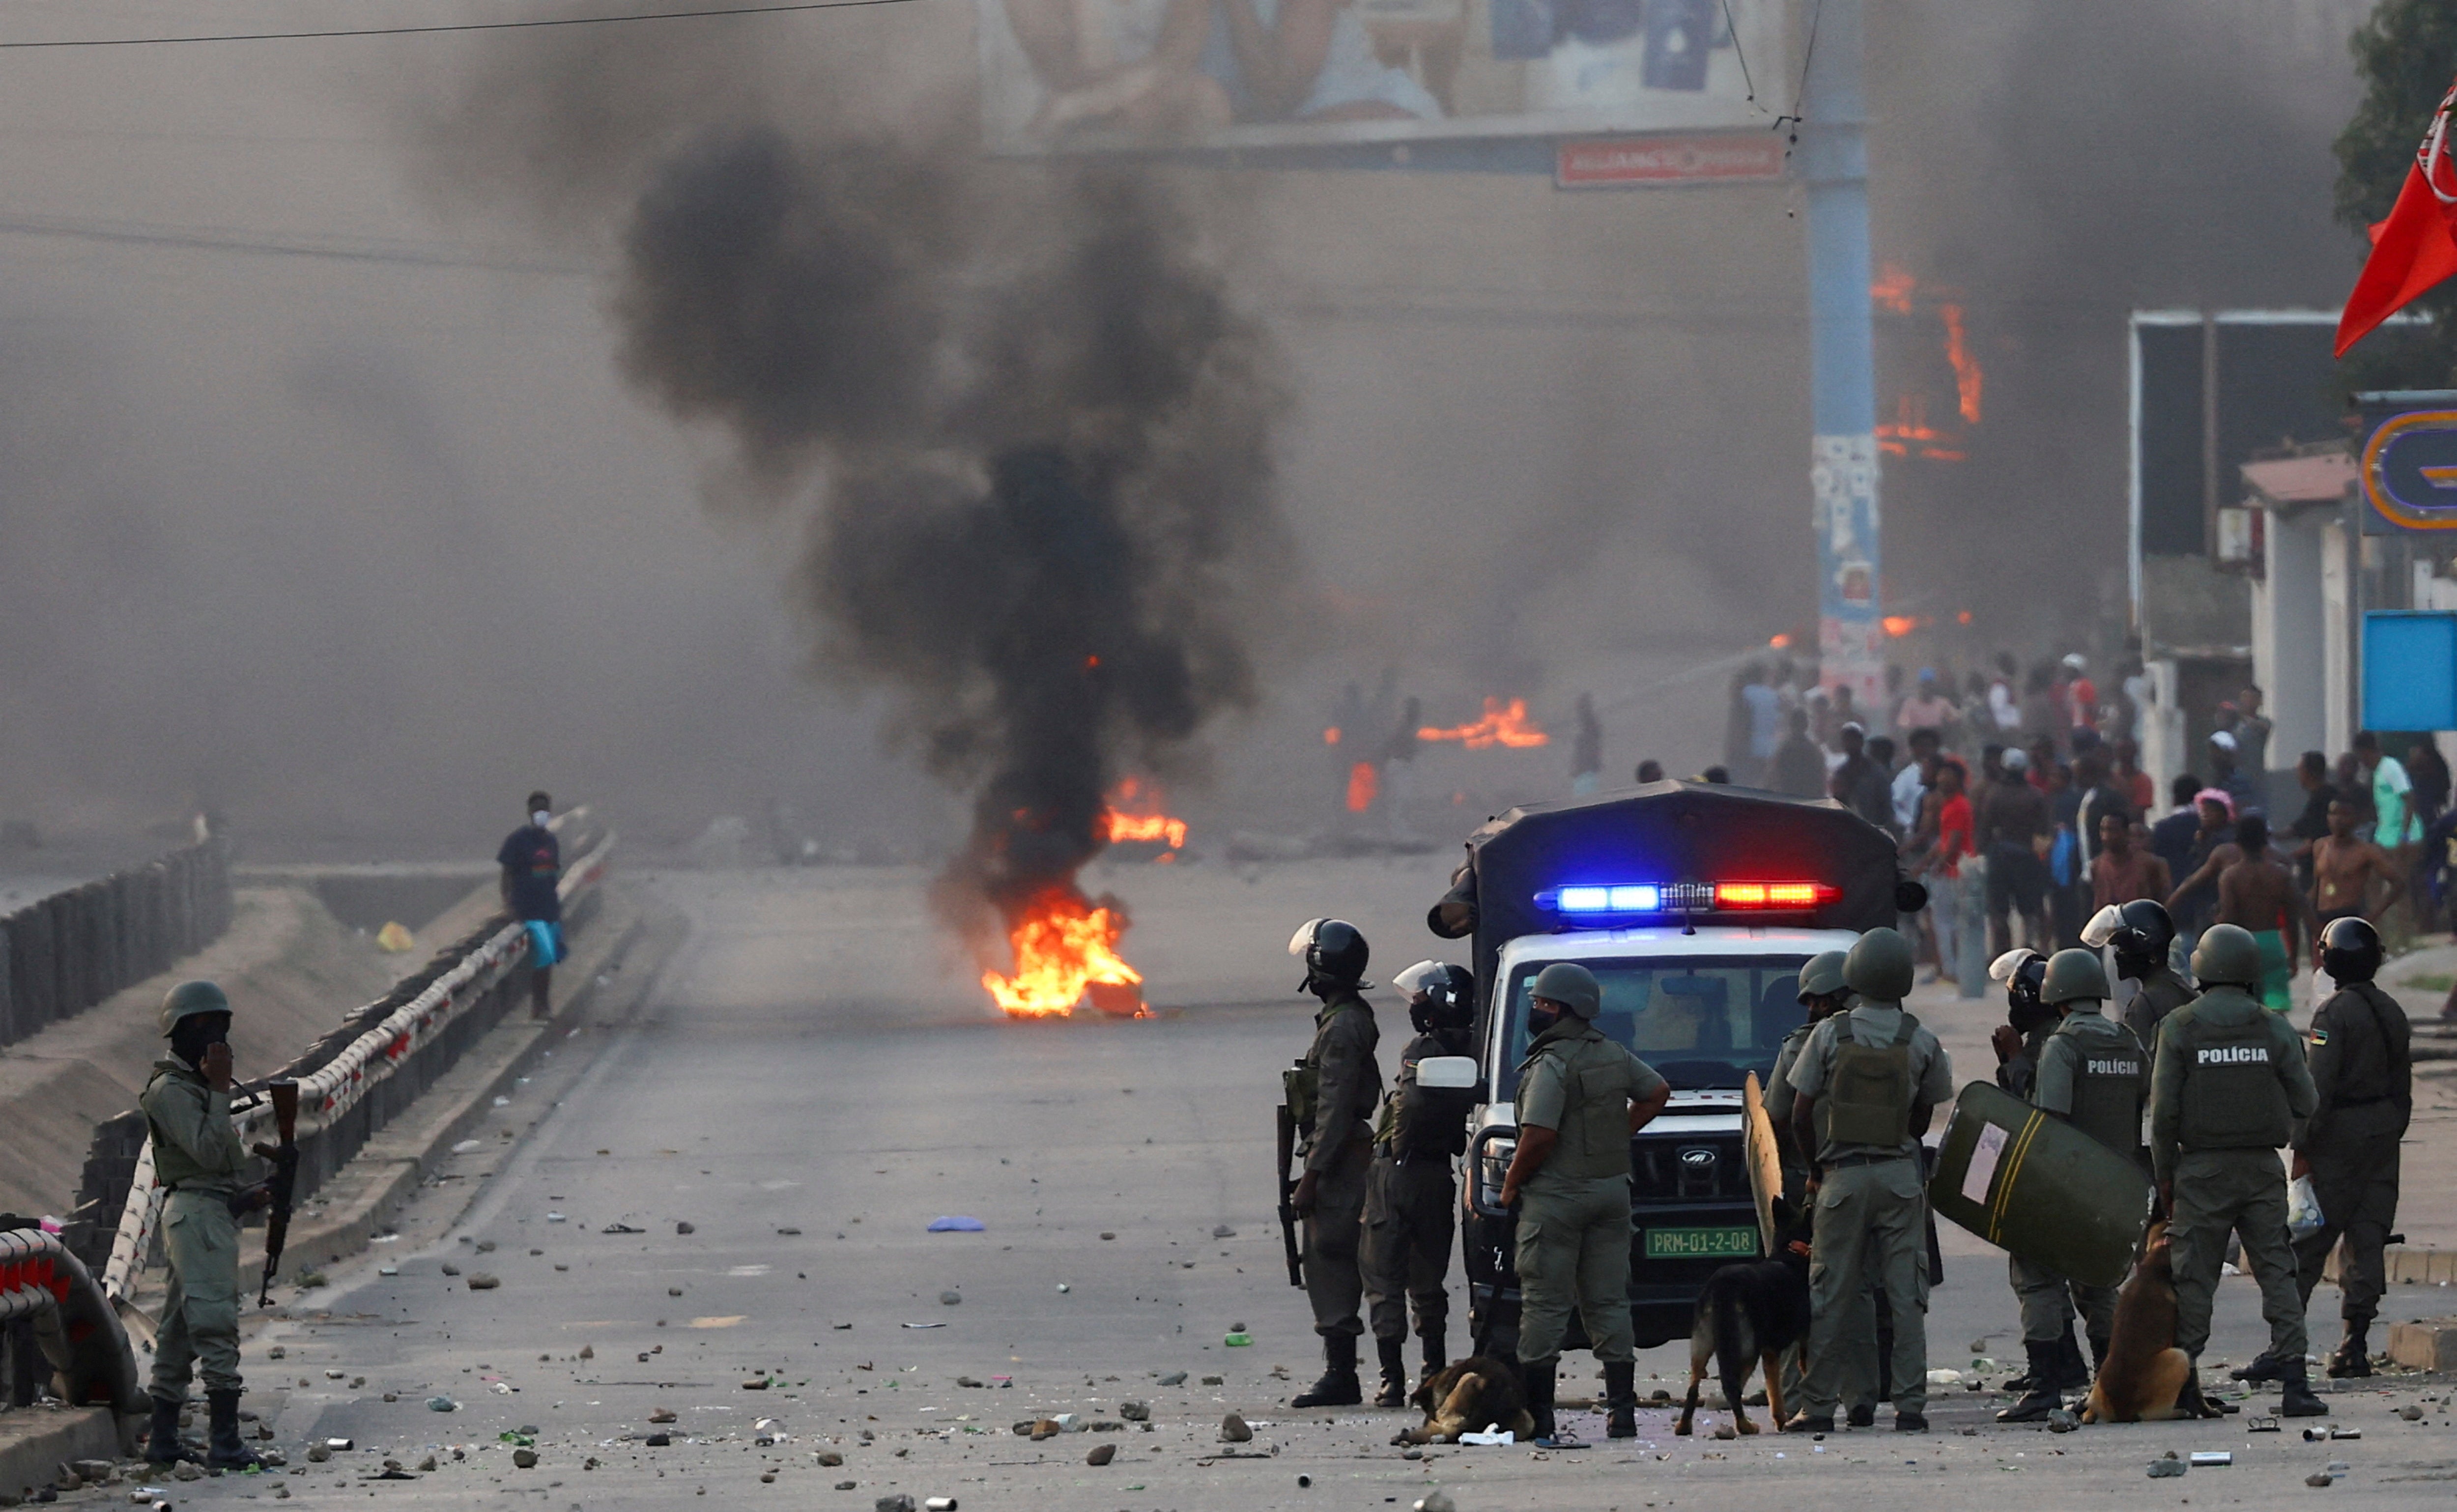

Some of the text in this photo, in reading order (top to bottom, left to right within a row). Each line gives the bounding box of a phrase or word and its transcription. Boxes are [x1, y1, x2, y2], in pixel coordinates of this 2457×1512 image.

[2198, 1046, 2268, 1063] POLÍCIA
[2087, 1058, 2139, 1074] POLÍCIA
[1654, 1231, 1750, 1253] PRM-01-2-08
